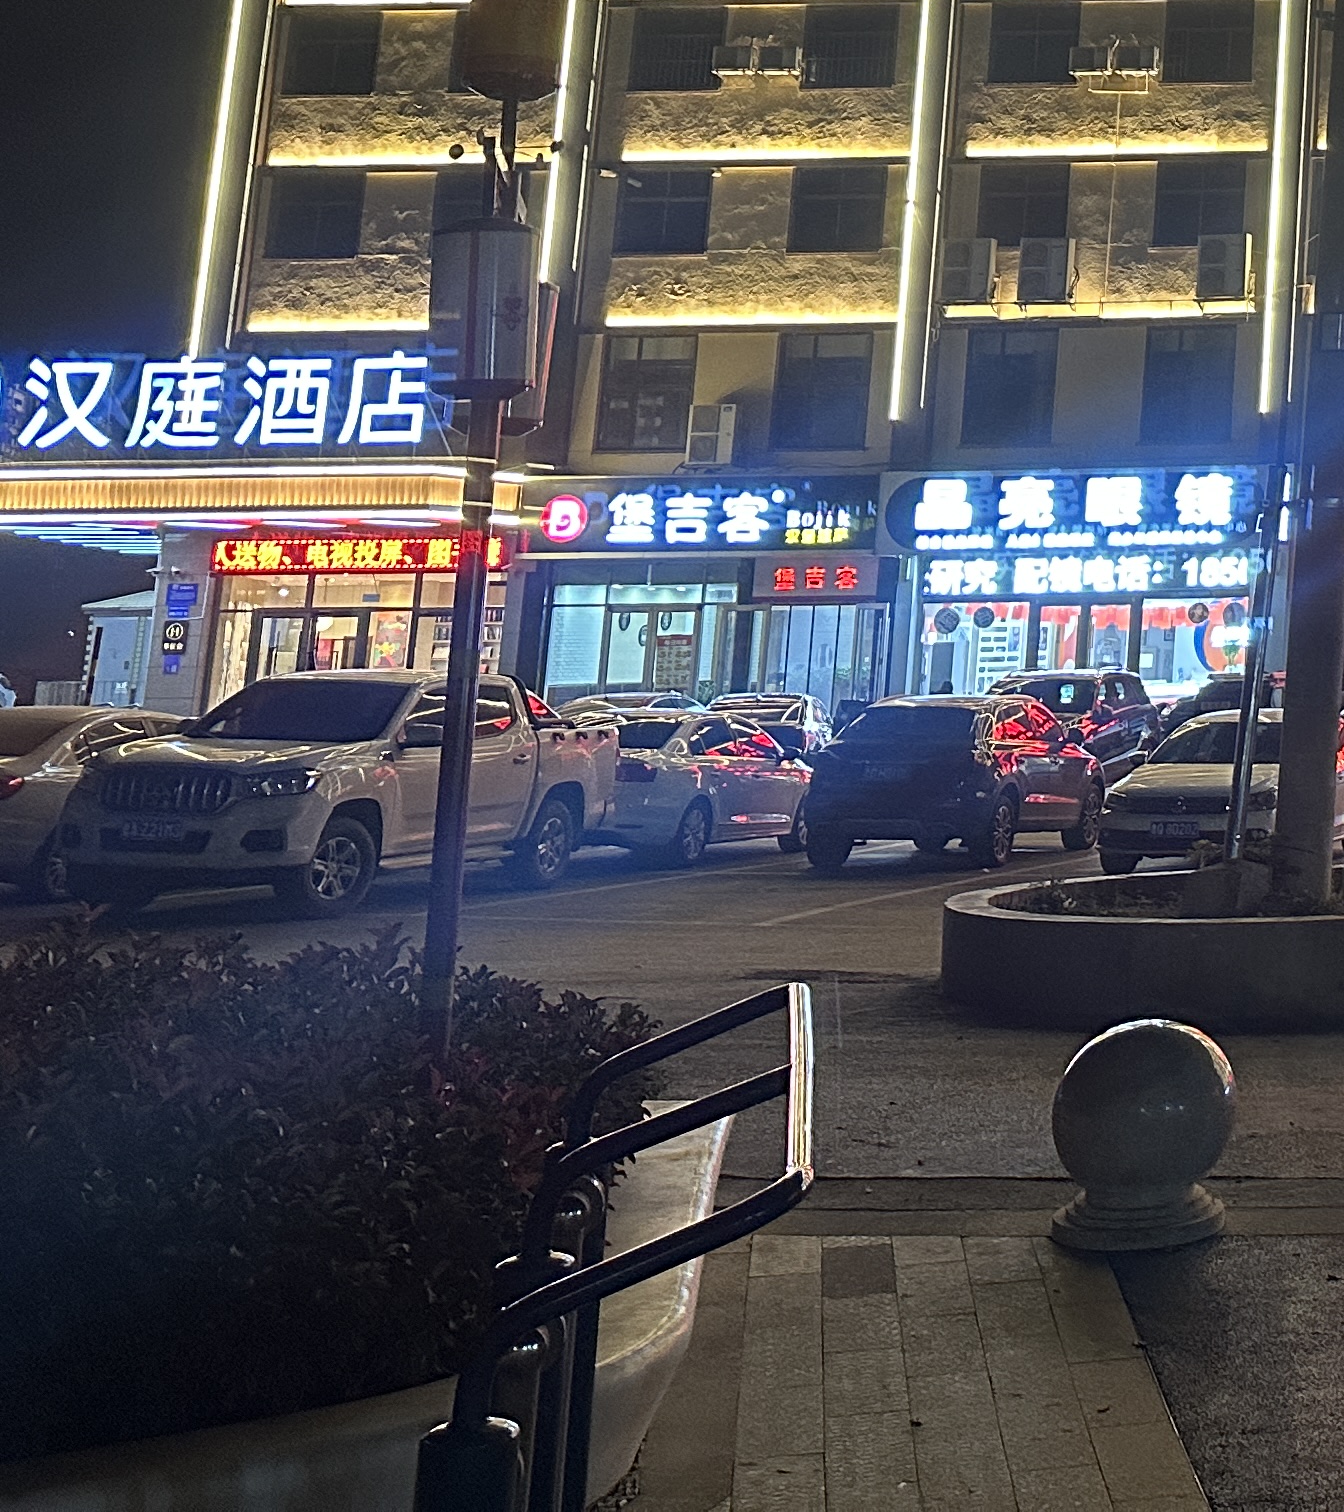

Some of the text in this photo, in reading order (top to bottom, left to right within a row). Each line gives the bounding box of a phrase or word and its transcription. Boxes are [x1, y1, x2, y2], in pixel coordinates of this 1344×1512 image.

[17, 350, 429, 449] 汉庭酒店
[606, 492, 770, 545] 堡吉客
[774, 566, 858, 592] 堡吉客
